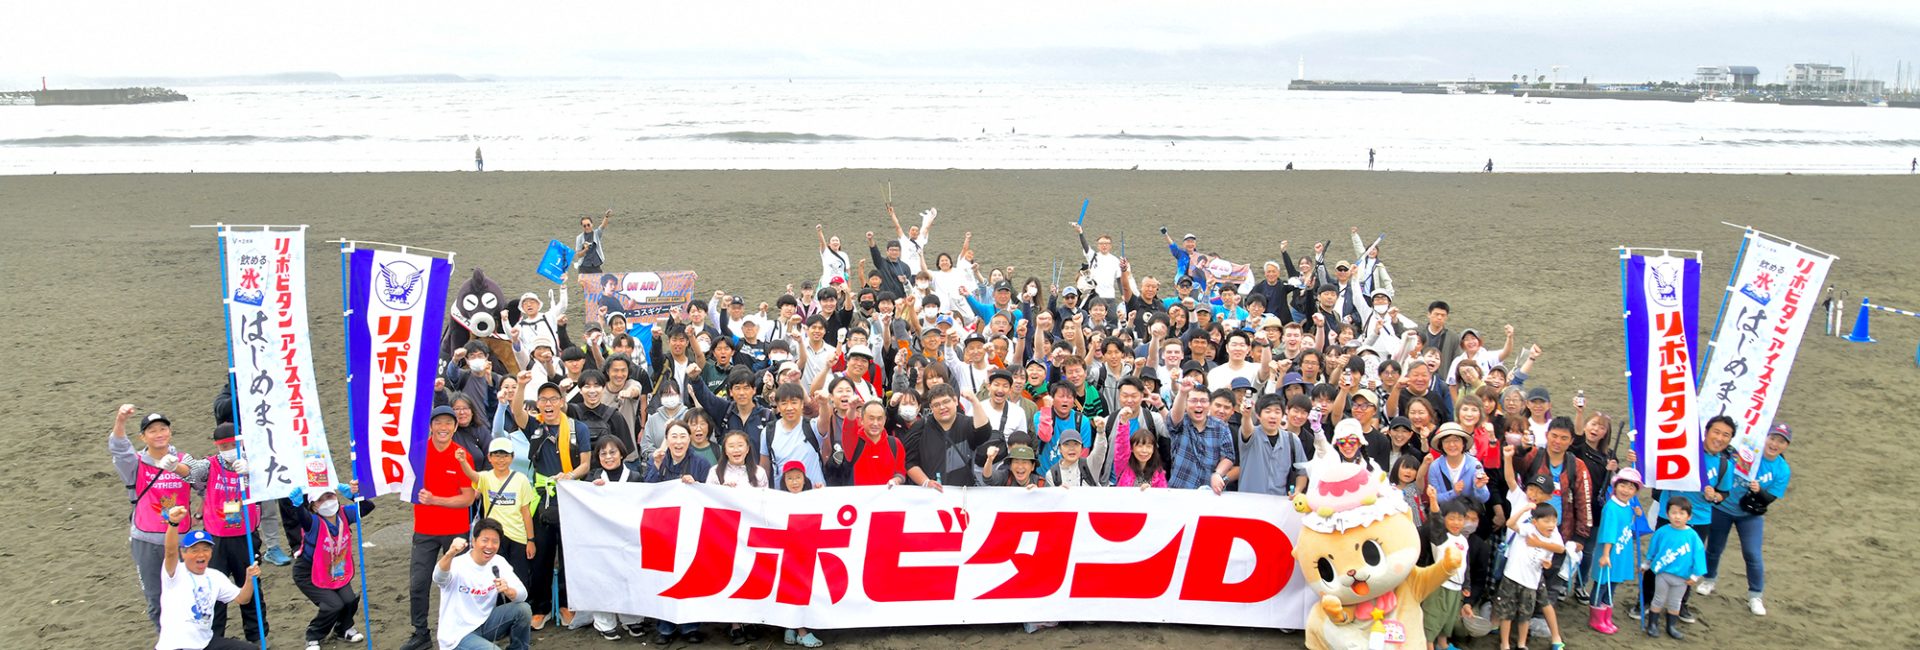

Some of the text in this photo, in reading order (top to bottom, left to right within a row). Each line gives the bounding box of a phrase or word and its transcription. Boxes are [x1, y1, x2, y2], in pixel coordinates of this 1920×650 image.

[240, 254, 267, 265] 飲める
[240, 267, 260, 289] 氷
[1753, 272, 1774, 290] 氷
[241, 310, 292, 488] はじめました
[274, 238, 309, 447] リポビタン アイススラリー
[1655, 310, 1691, 481] リポビタンD
[1743, 258, 1815, 435] リポビタン アイススラリー
[640, 504, 1297, 606] リポビタンD
